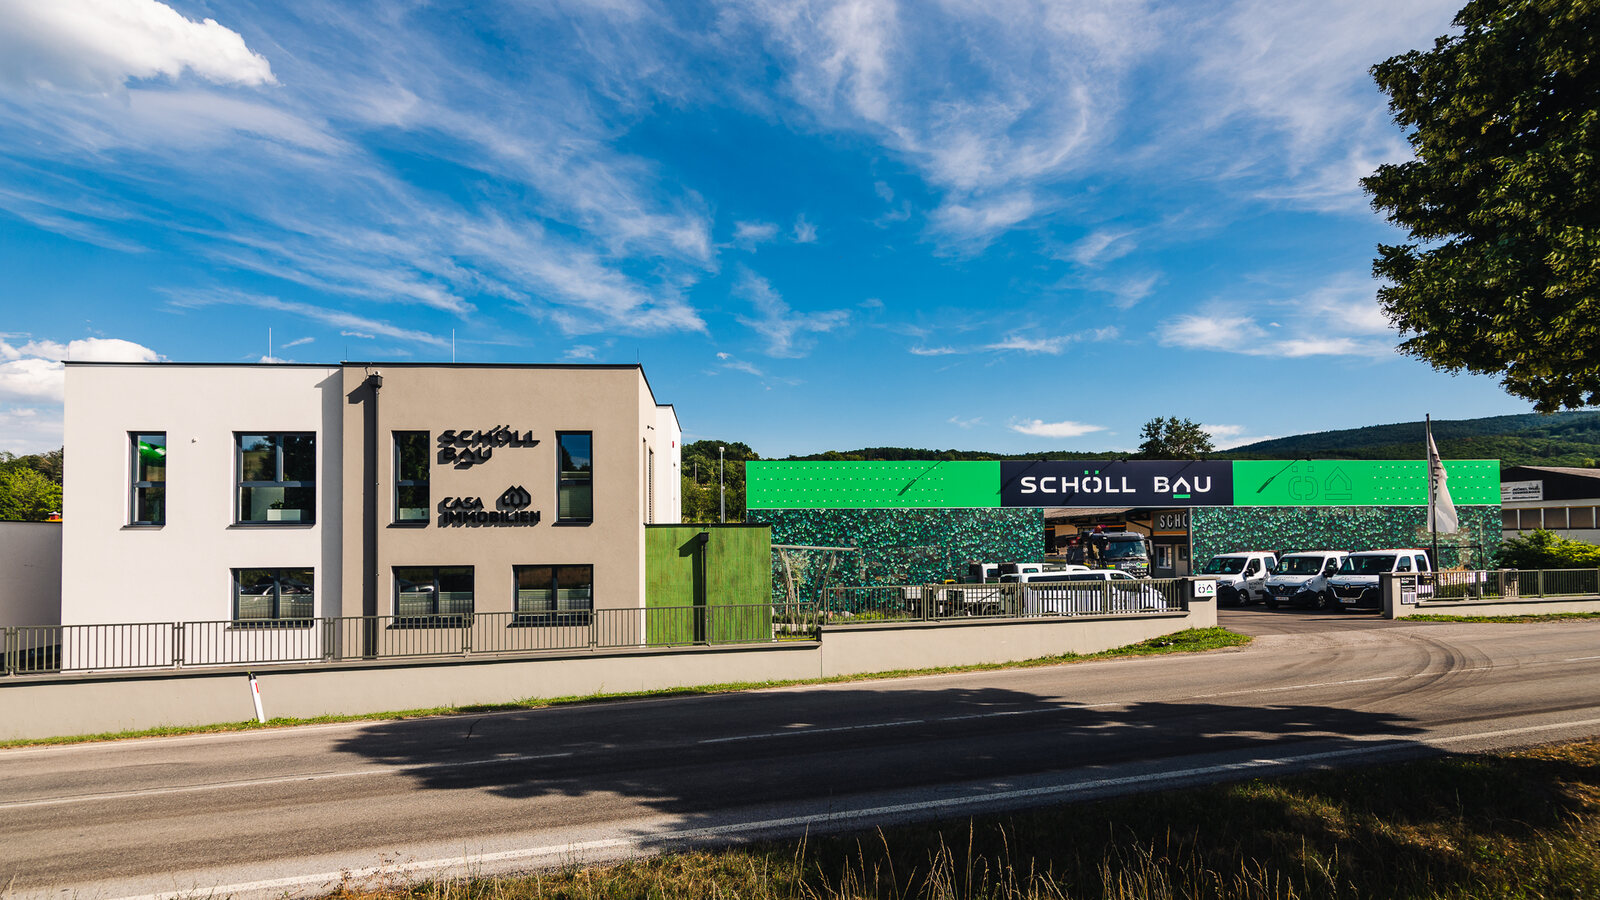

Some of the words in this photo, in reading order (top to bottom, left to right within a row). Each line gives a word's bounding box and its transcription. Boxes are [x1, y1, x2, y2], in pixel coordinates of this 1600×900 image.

[438, 425, 540, 447] SCHÖLL
[438, 447, 492, 469] BAU
[1020, 470, 1136, 493] SCHÖLL
[1153, 476, 1211, 499] BAU
[438, 497, 484, 512] CASA
[438, 511, 540, 528] IMMOBILIEN
